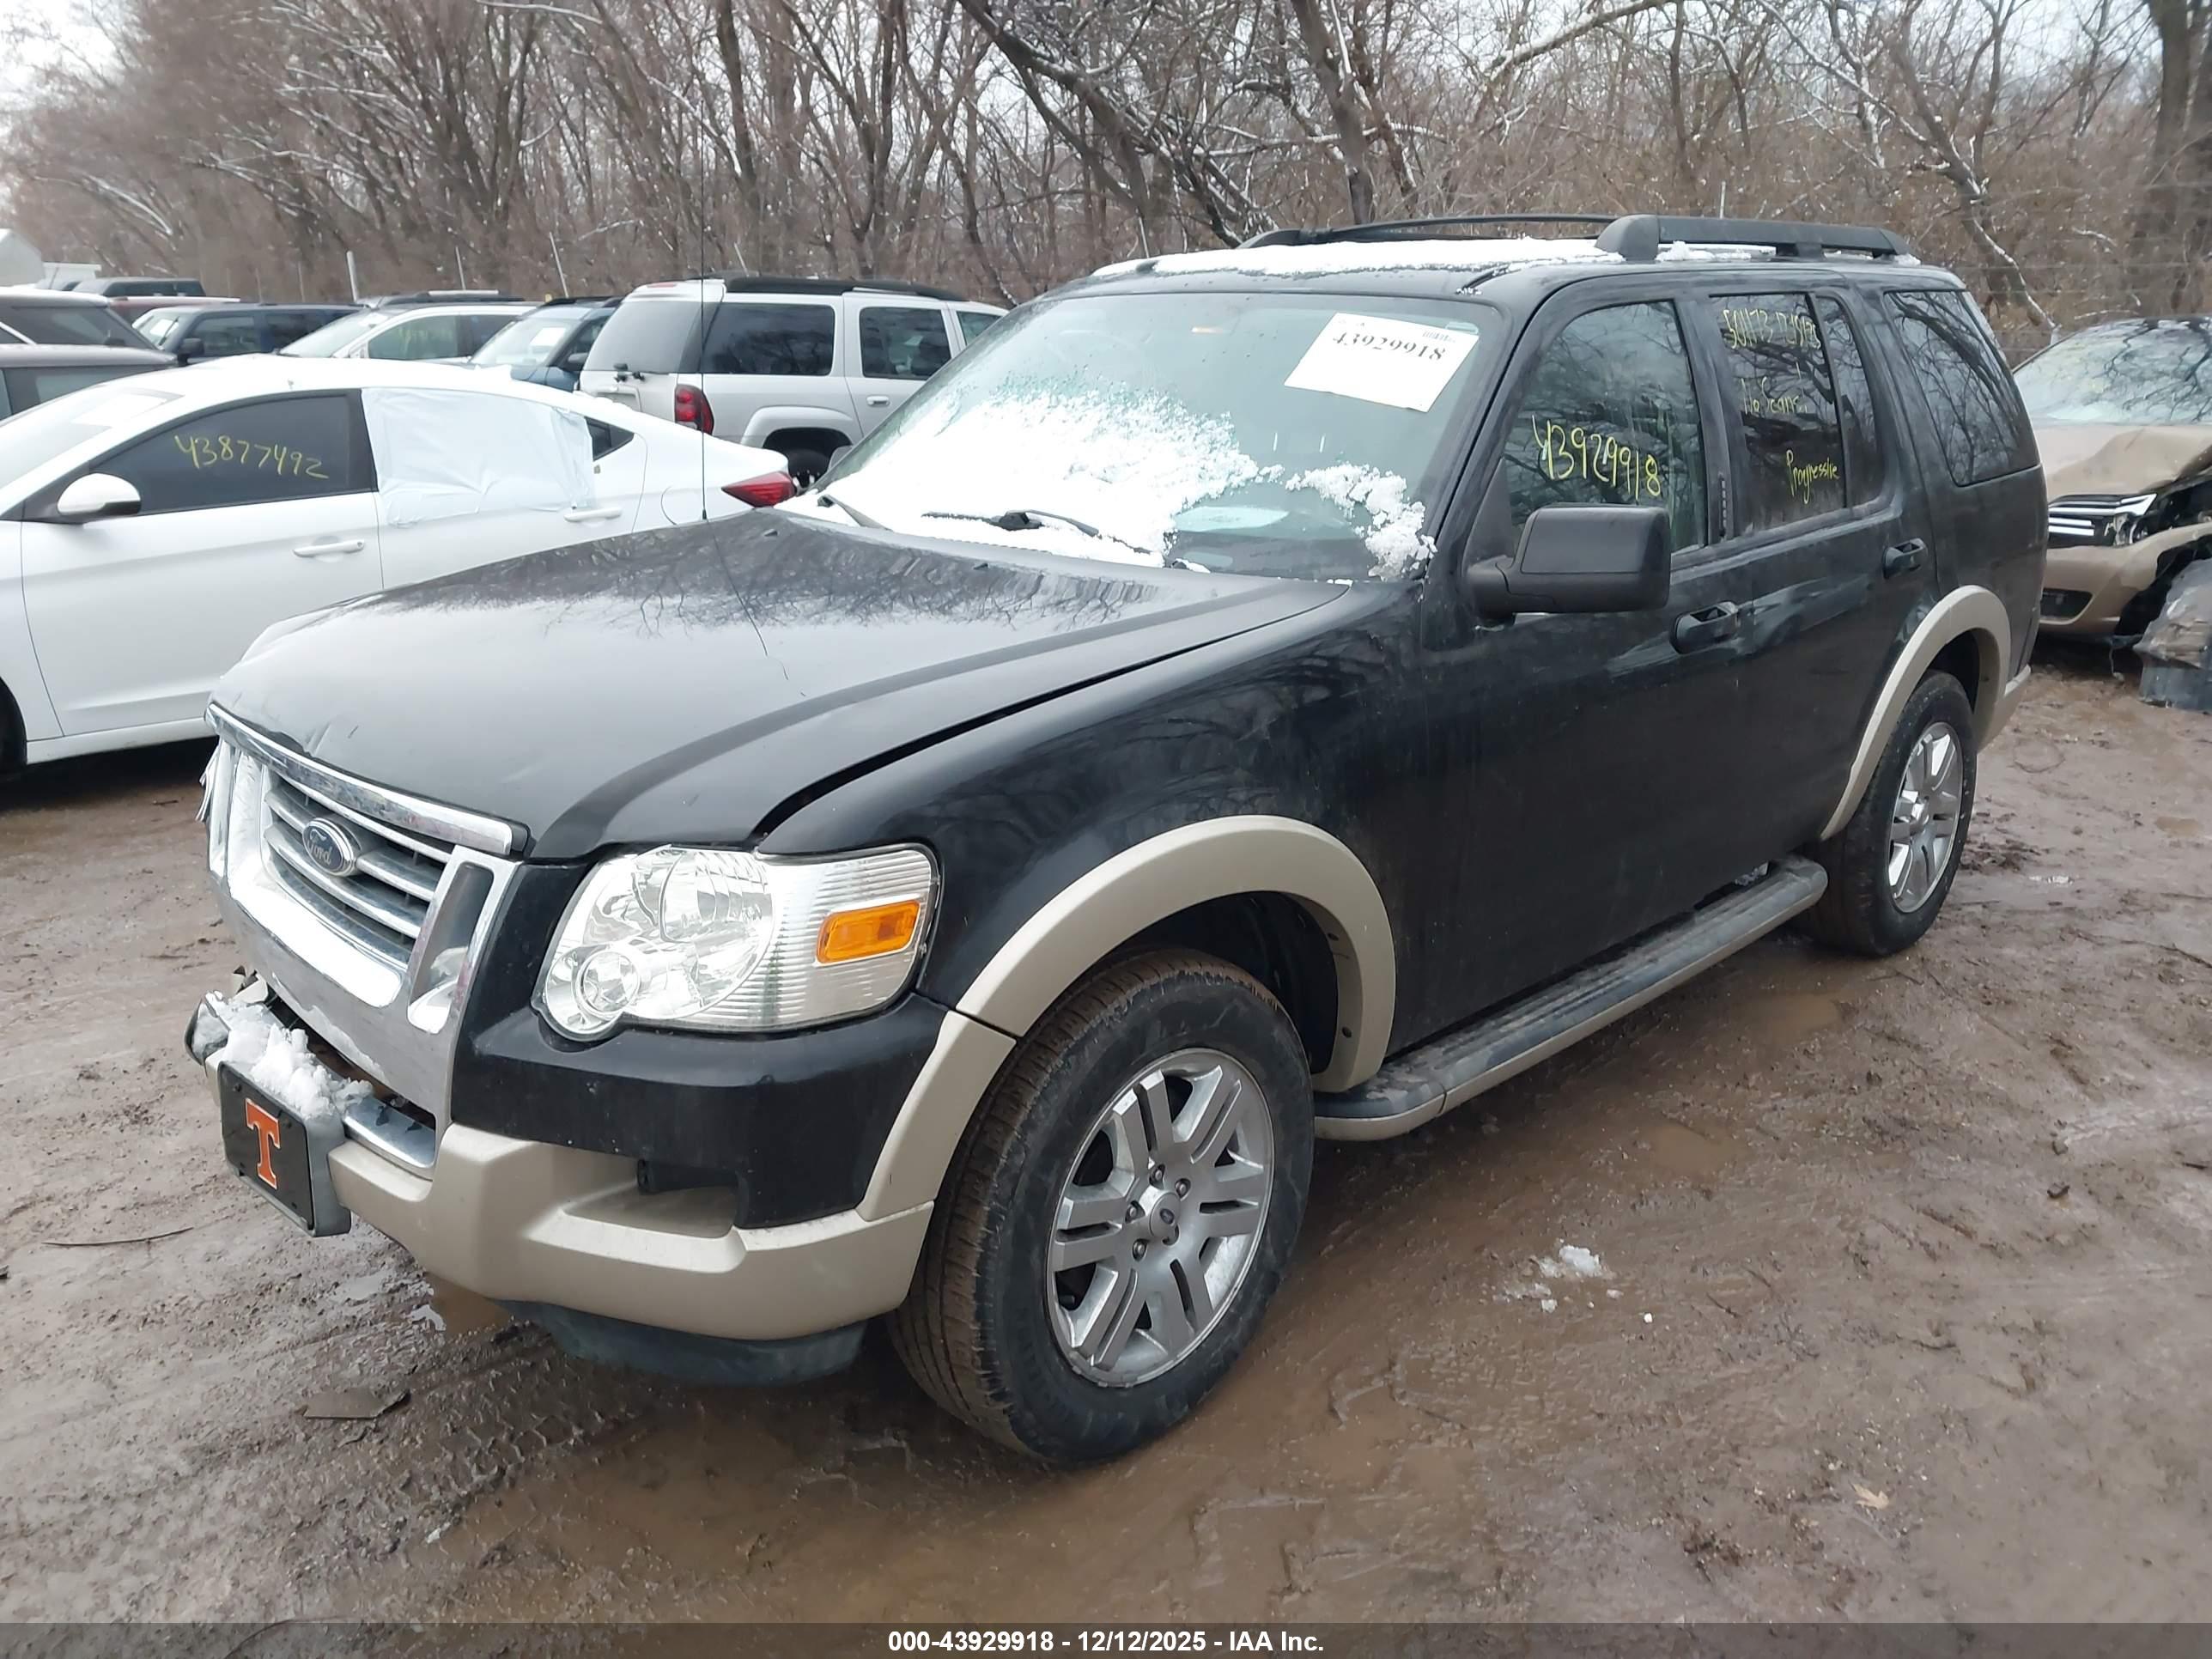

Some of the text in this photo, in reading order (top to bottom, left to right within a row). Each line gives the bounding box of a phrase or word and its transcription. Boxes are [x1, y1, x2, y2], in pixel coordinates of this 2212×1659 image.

[1333, 331, 1446, 361] 43929918
[174, 435, 329, 478] 43877492
[1532, 415, 1662, 501] 43929918
[307, 828, 332, 866] Ford
[245, 1097, 281, 1189] T
